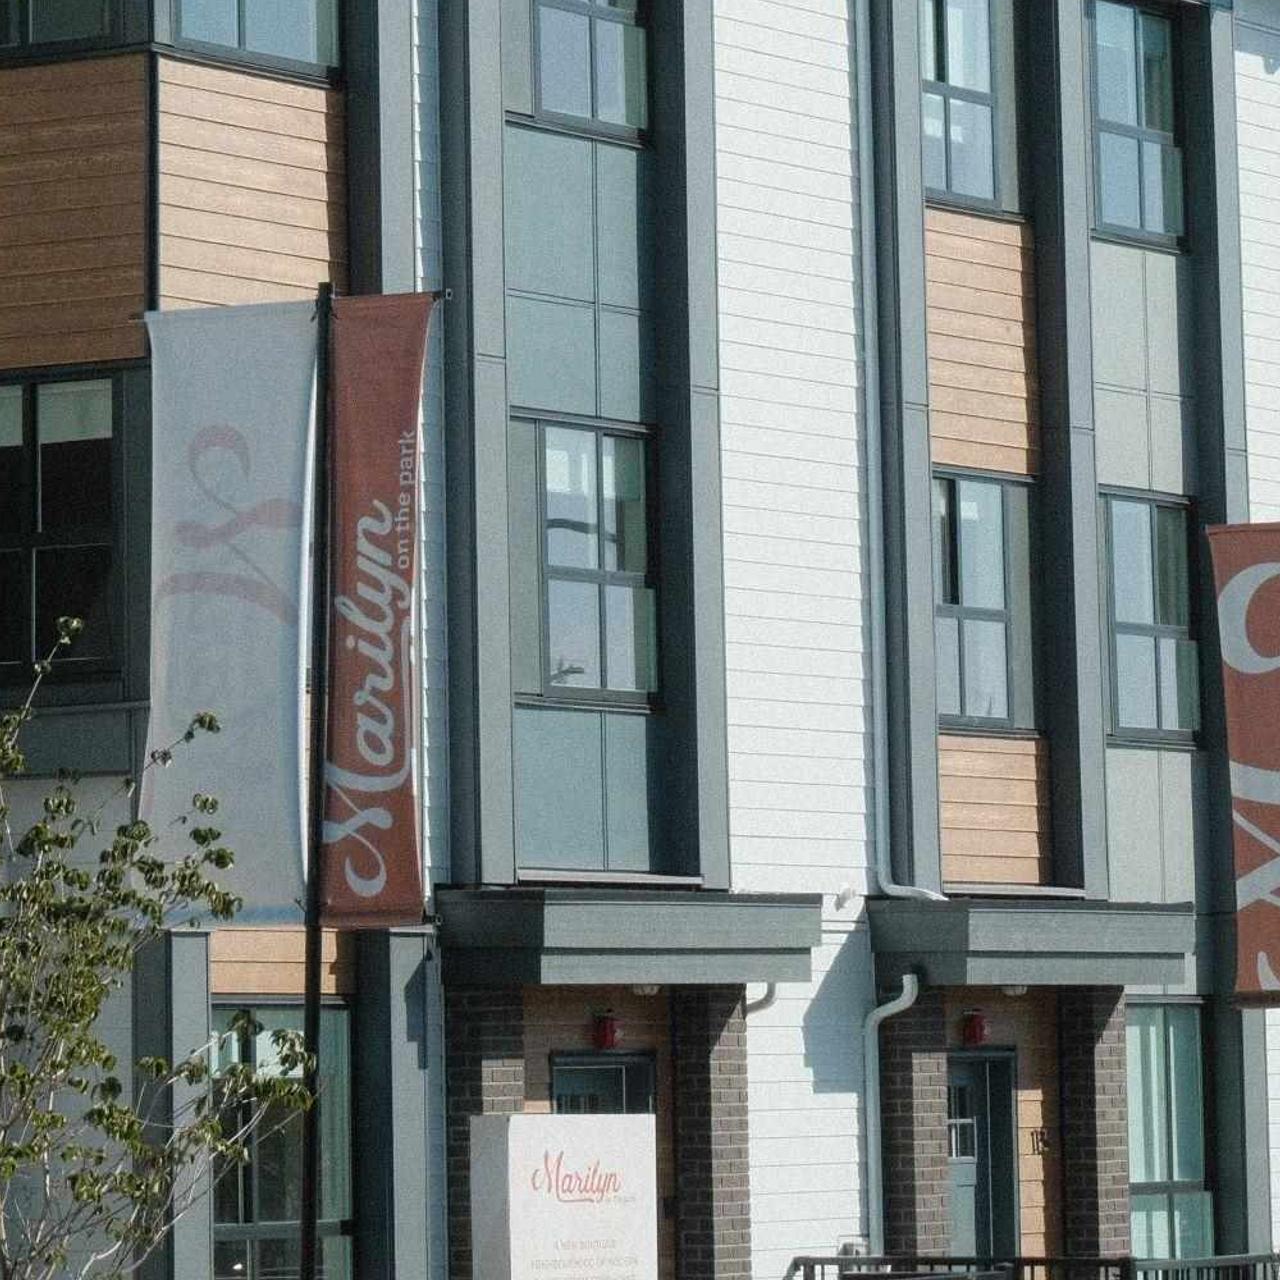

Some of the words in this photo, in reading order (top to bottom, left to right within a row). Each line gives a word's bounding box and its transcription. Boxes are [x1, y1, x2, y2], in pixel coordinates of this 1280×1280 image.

[397, 430, 415, 485] park
[394, 491, 410, 531] the
[397, 539, 410, 569] on
[323, 499, 414, 898] Marilyn
[531, 1150, 622, 1203] Marilyn
